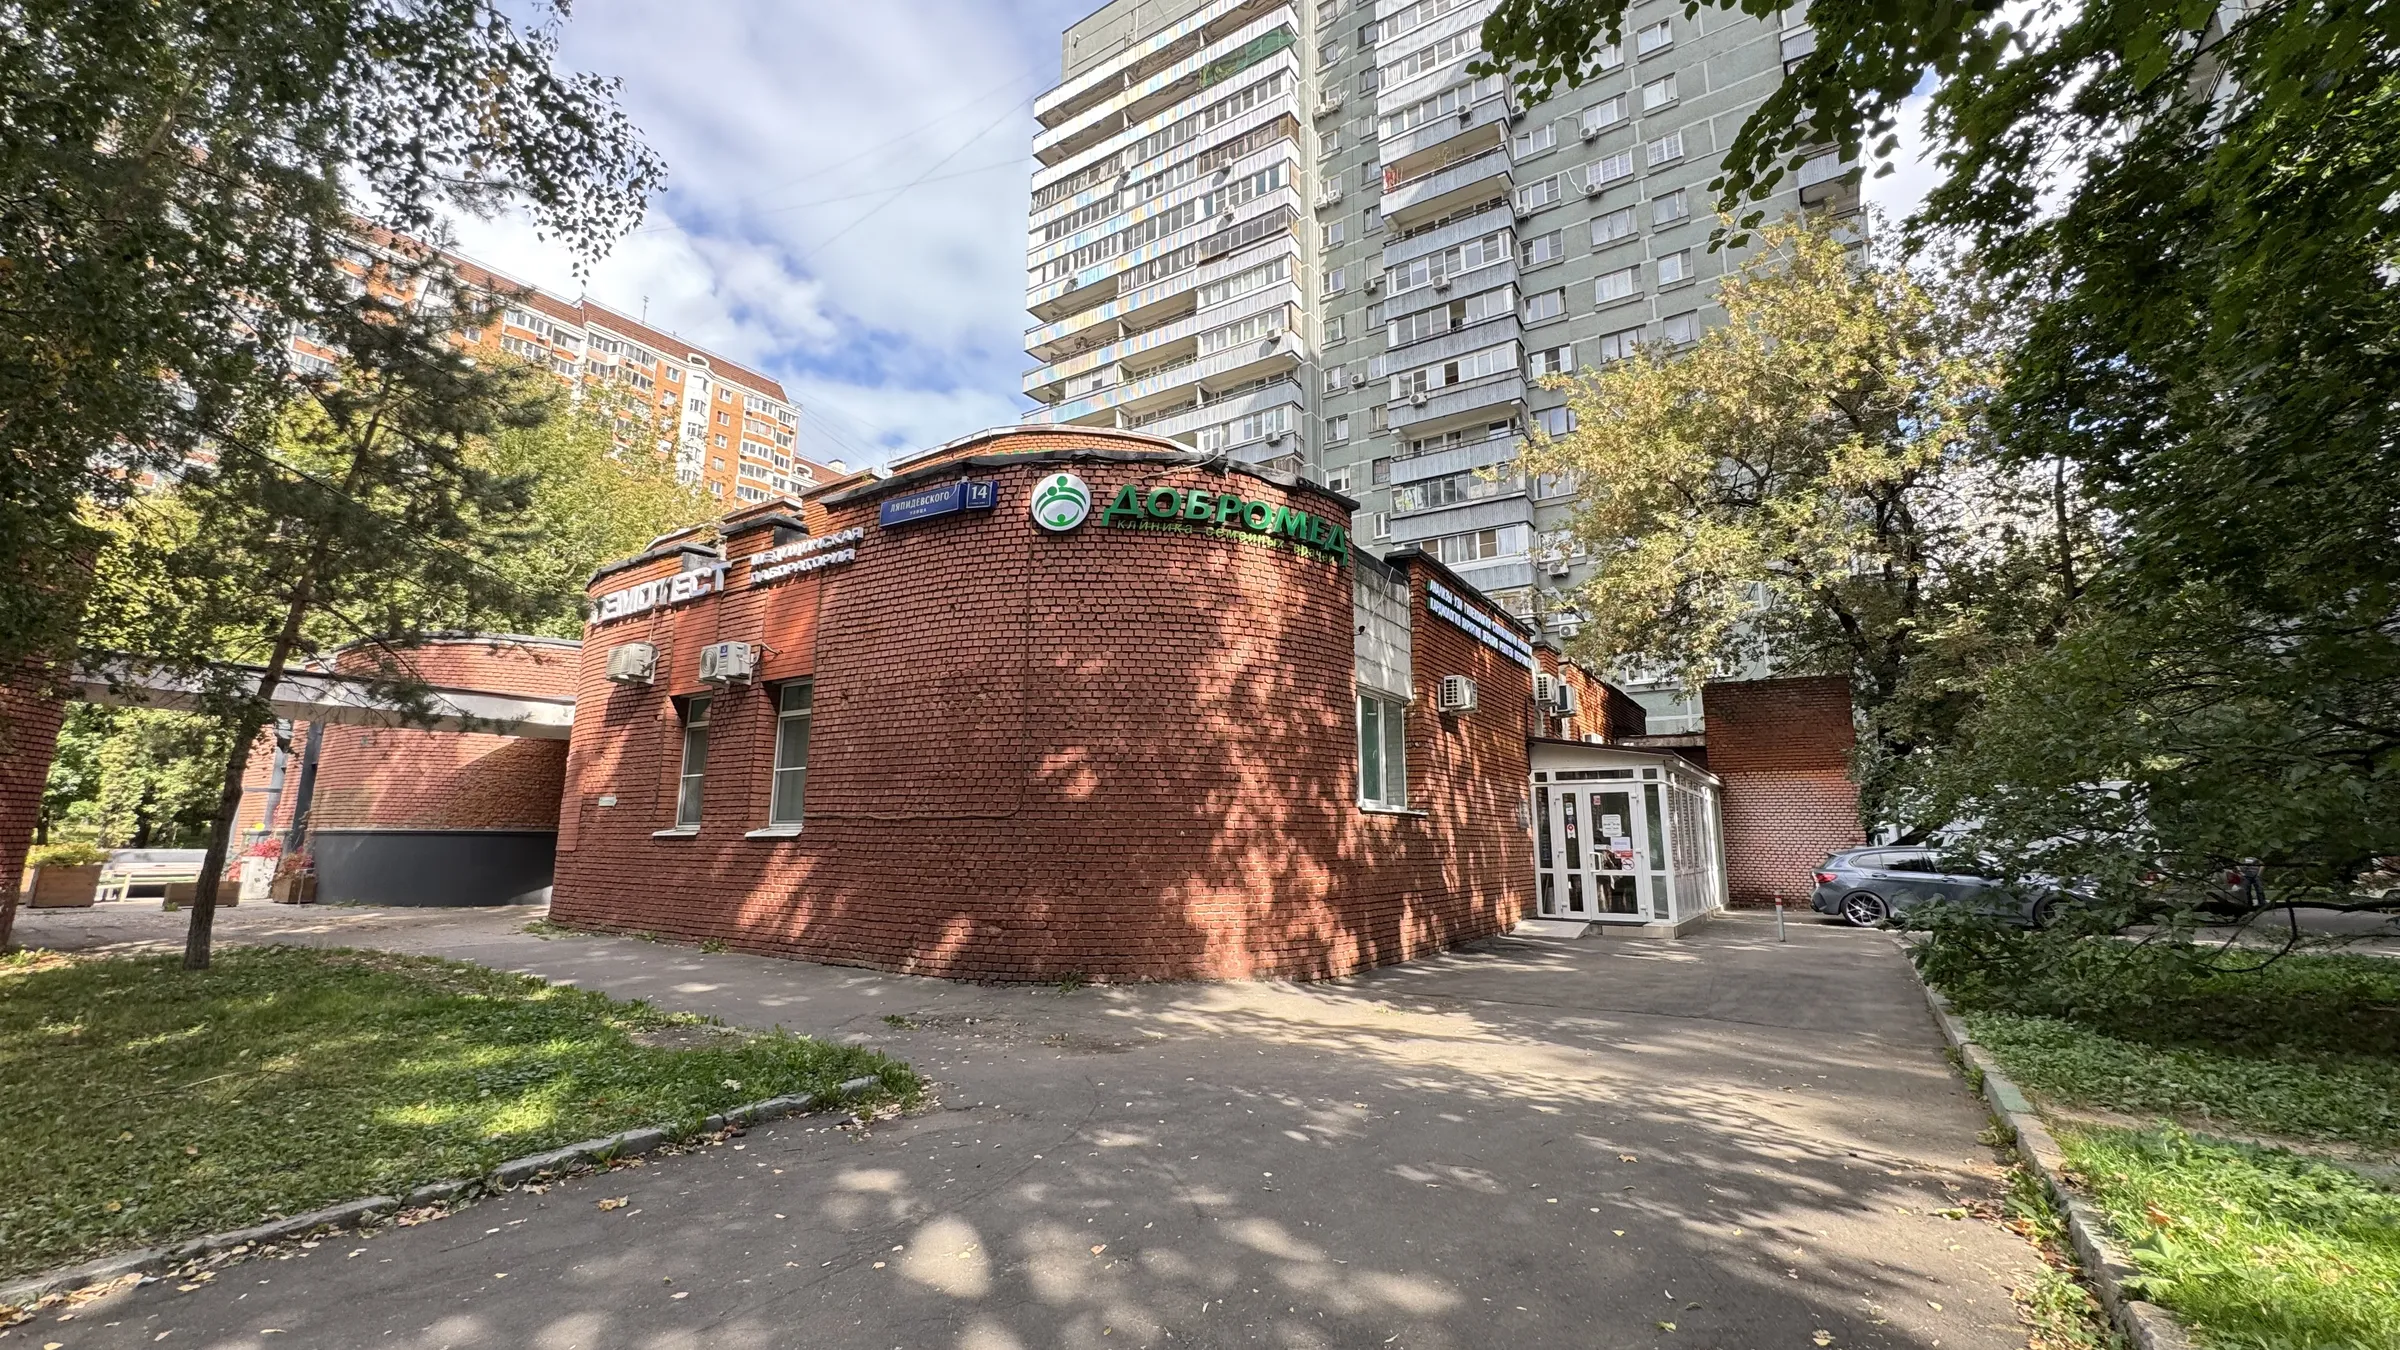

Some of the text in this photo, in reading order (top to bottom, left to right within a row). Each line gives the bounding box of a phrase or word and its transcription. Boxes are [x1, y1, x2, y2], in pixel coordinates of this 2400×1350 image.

[890, 491, 950, 513] ЛЯПИДЕВСКОГО
[972, 485, 988, 500] 14
[1101, 483, 1348, 567] ДОБРОМЕД
[1116, 520, 1193, 535] клиника
[750, 526, 864, 566] МЕДИЦИНСКАЯ
[750, 548, 856, 583] ЛАБОРАТОРИЯ
